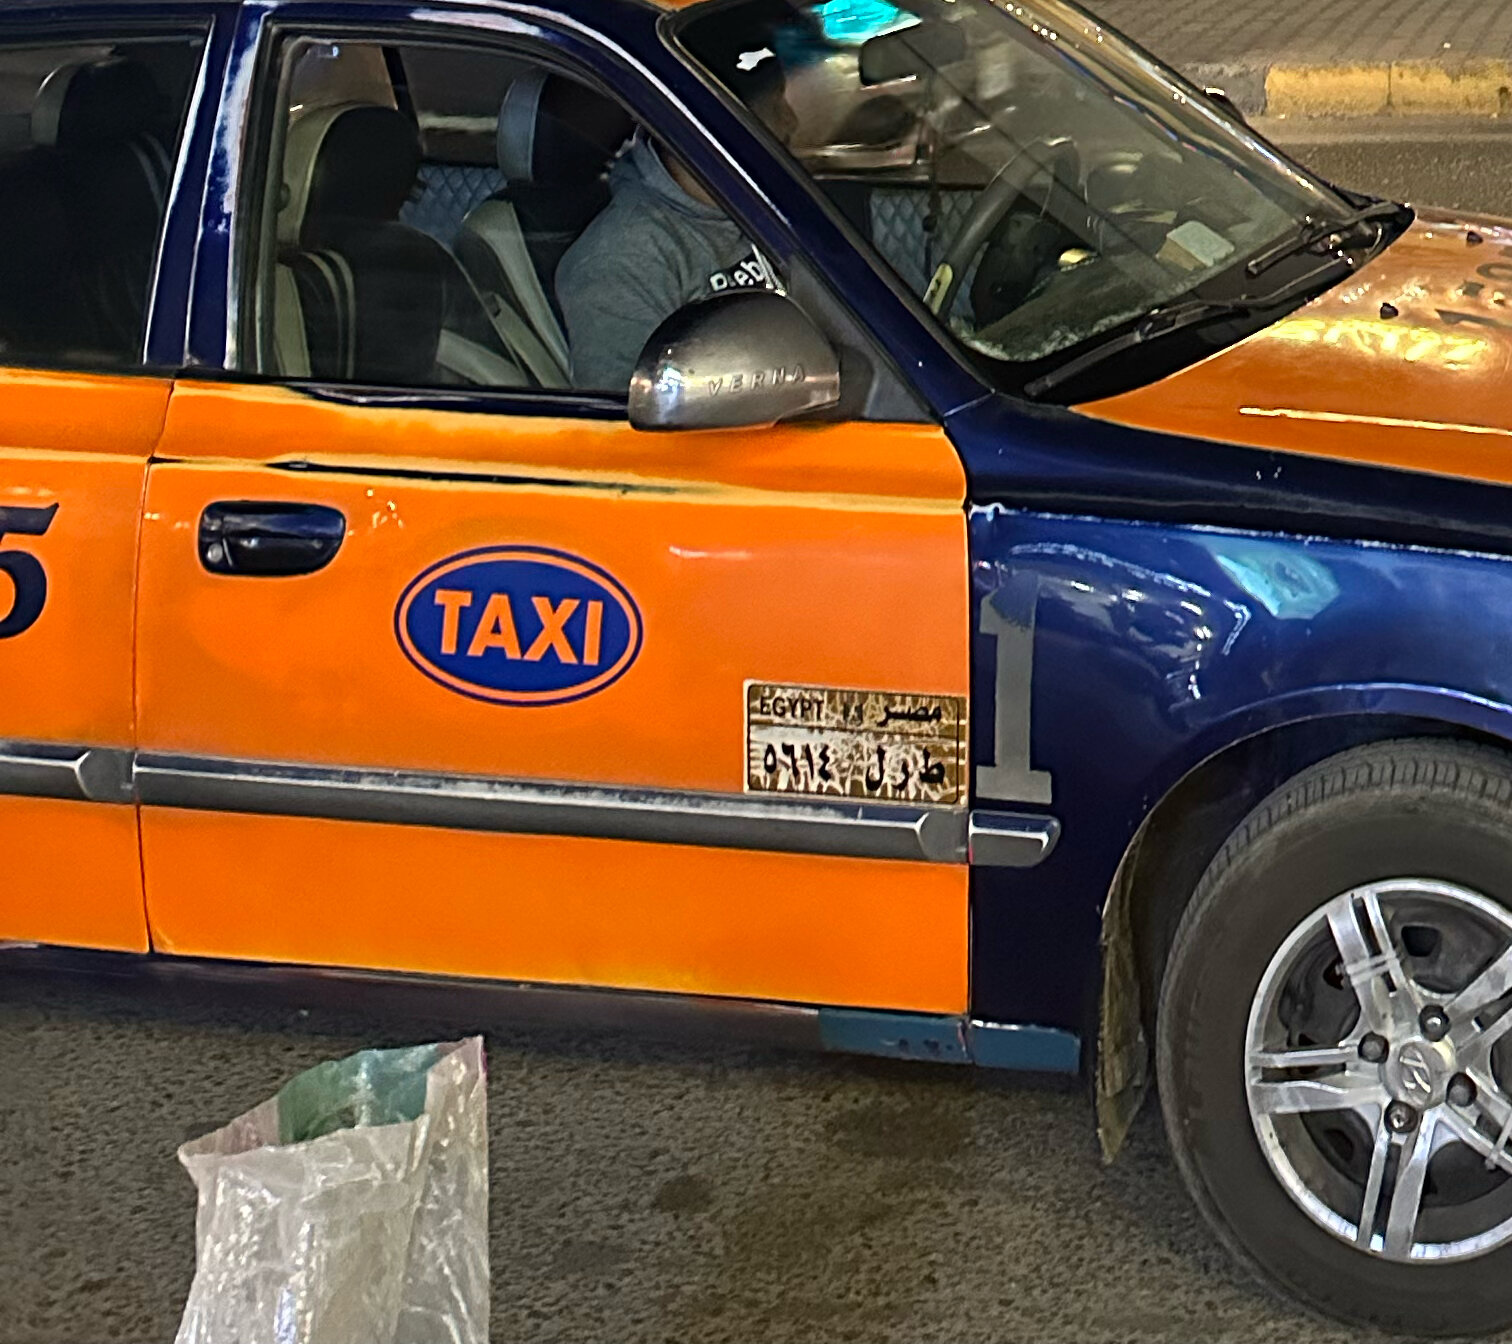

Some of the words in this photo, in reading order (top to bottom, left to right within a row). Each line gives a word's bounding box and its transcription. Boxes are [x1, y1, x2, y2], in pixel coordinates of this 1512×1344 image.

[708, 362, 807, 398] VERNA
[433, 588, 604, 667] TAXI
[975, 568, 1052, 805] 1
[759, 695, 825, 721] EGYPT
[876, 704, 942, 727] مصر
